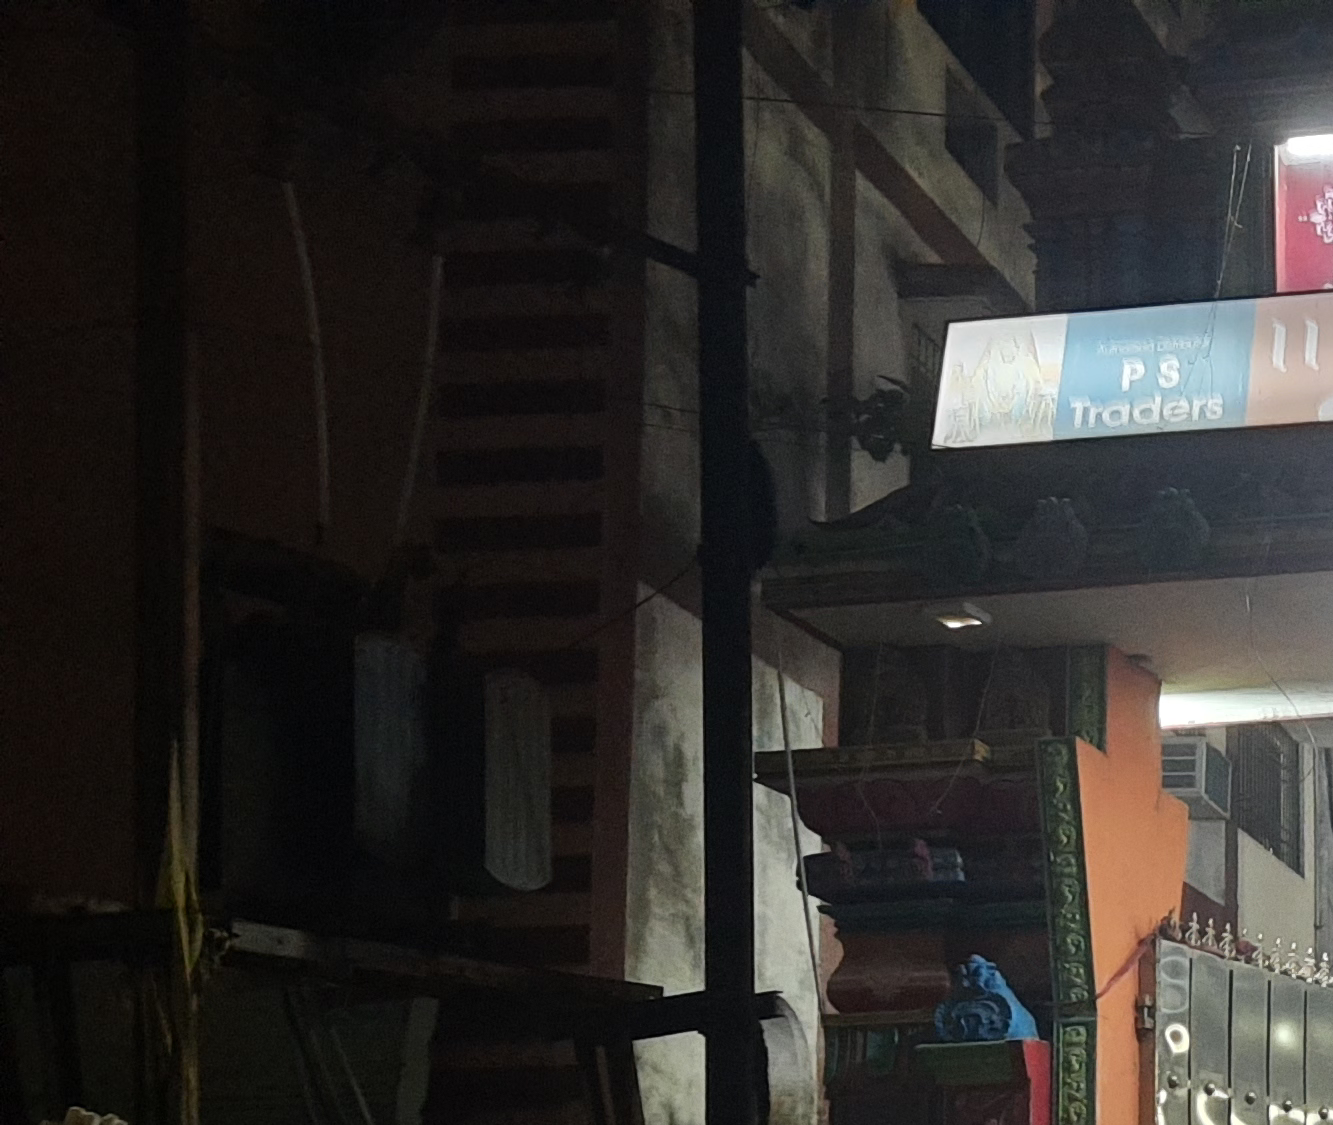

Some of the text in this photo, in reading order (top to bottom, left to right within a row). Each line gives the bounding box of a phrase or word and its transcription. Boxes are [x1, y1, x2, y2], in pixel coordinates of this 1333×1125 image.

[1120, 353, 1181, 392] P S
[1068, 391, 1224, 430] Traders
